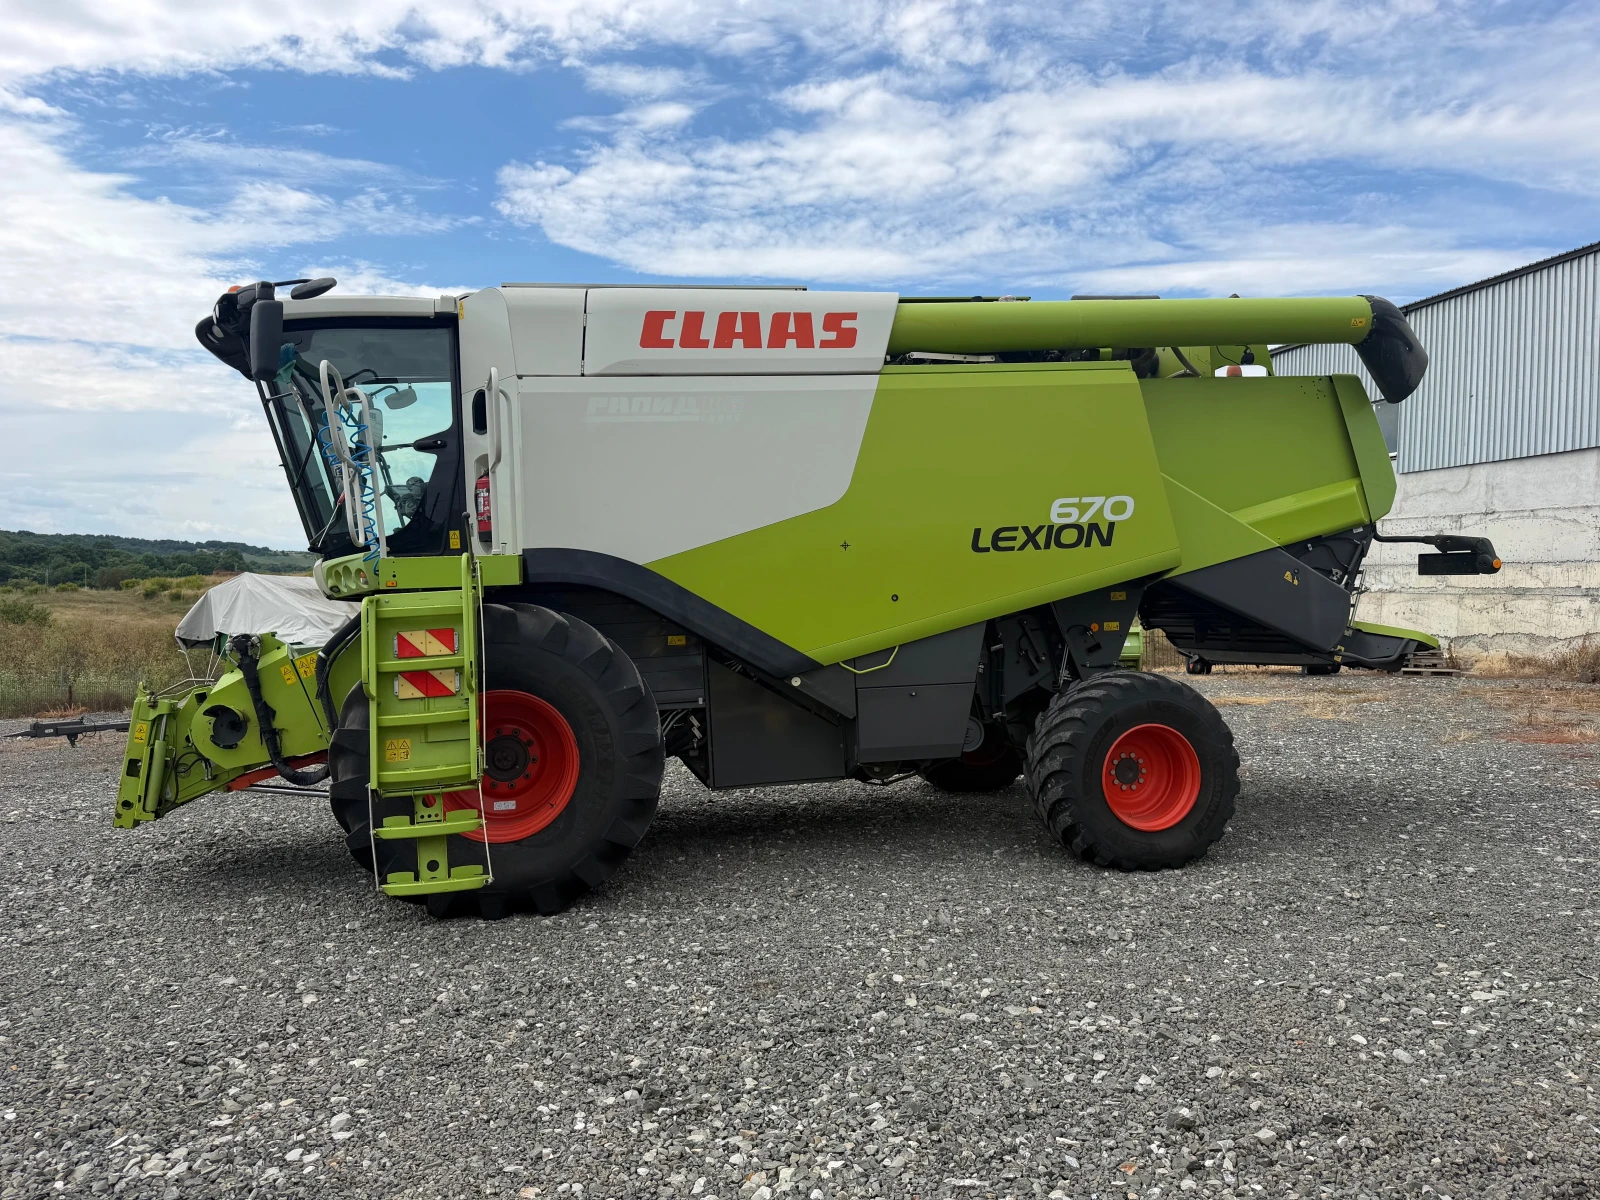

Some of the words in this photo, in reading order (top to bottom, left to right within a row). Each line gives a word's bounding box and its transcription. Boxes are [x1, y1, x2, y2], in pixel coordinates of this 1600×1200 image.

[640, 311, 858, 348] CLAAS
[1050, 496, 1134, 524] 670
[971, 522, 1116, 553] LEXION
